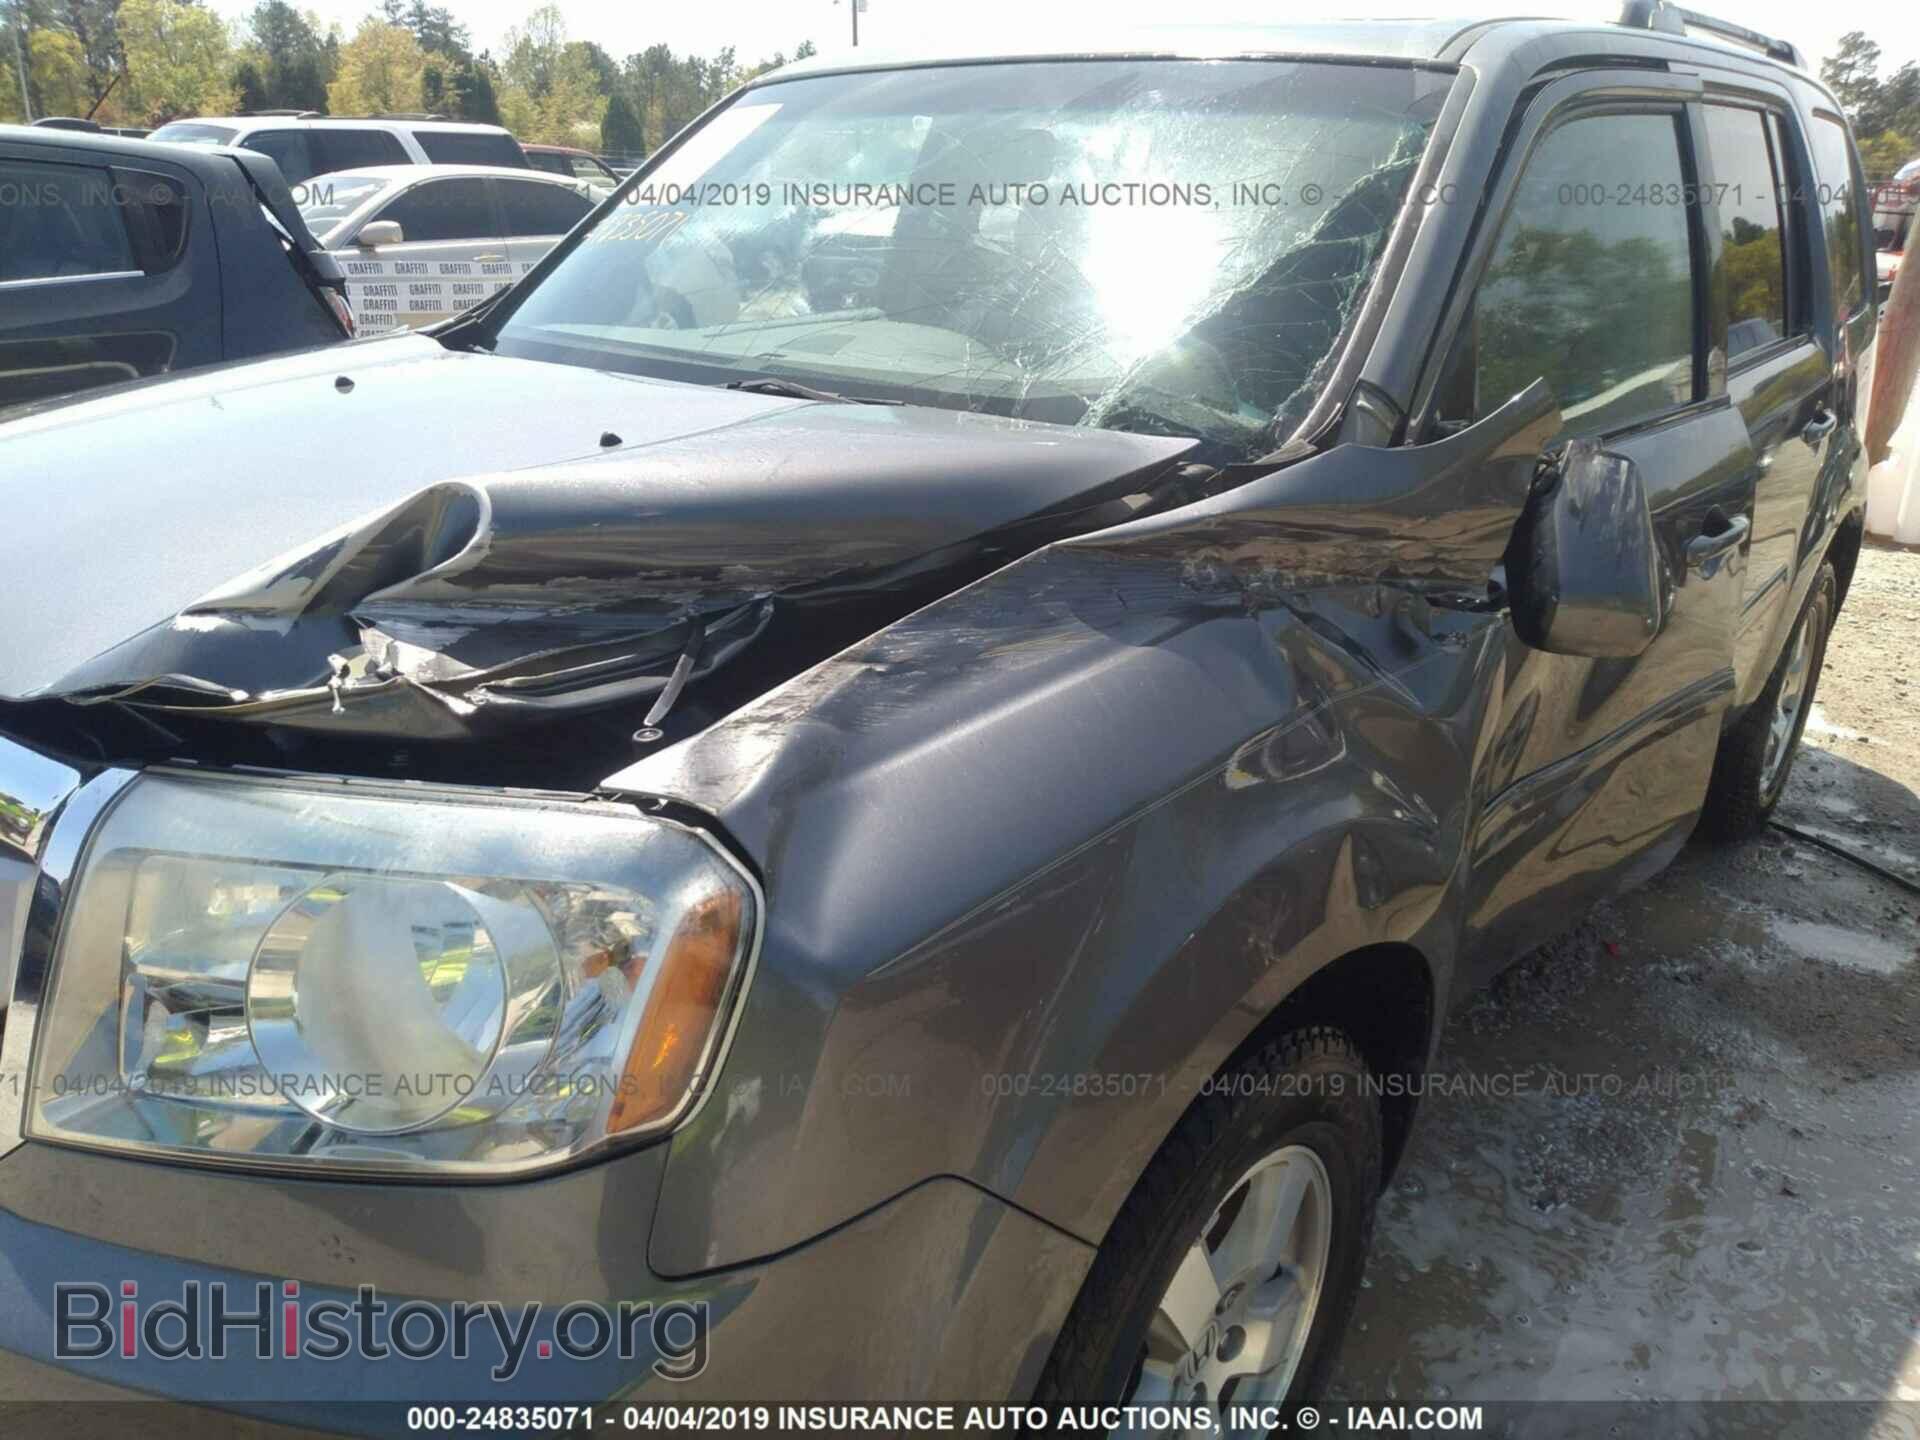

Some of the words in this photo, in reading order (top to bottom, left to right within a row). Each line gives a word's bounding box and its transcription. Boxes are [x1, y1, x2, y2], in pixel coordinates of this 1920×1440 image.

[347, 263, 384, 275] GRAFFITI
[394, 262, 429, 275] GRAFFITI
[439, 263, 472, 275] GRAFFITI
[481, 263, 513, 275] GRAFFITI
[363, 284, 399, 297] GRAFFITI
[409, 283, 442, 296] GRAFFITI
[452, 283, 484, 295] GRAFFITI
[363, 298, 398, 311] GRAFFITI
[409, 299, 442, 312] GRAFFITI
[359, 313, 393, 326] GRAFFITI
